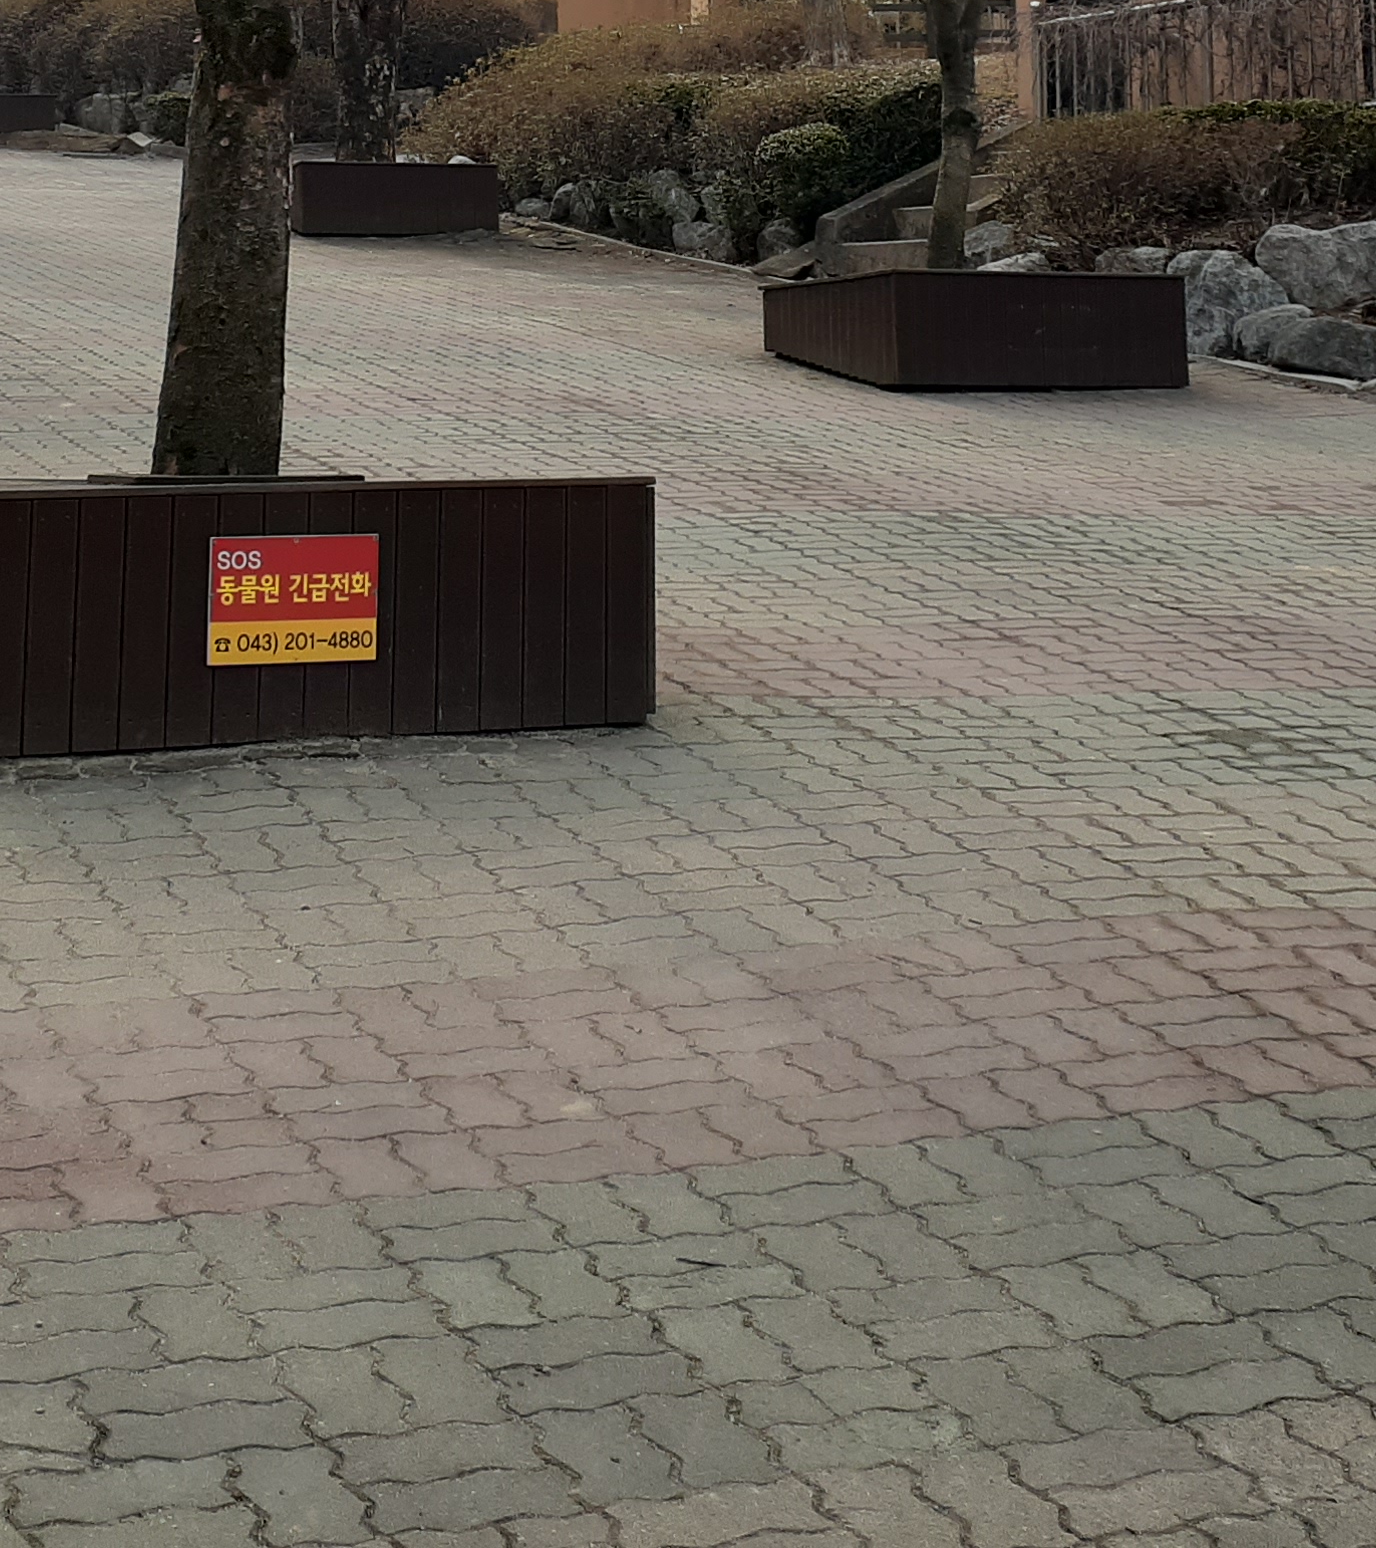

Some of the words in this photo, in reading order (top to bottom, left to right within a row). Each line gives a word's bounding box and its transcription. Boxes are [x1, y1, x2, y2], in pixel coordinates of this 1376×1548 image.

[217, 550, 262, 570] SOS
[216, 574, 281, 606] 동물원
[289, 571, 372, 603] 긴급전화
[236, 632, 279, 655] 043)
[284, 630, 373, 651] 201-4880
